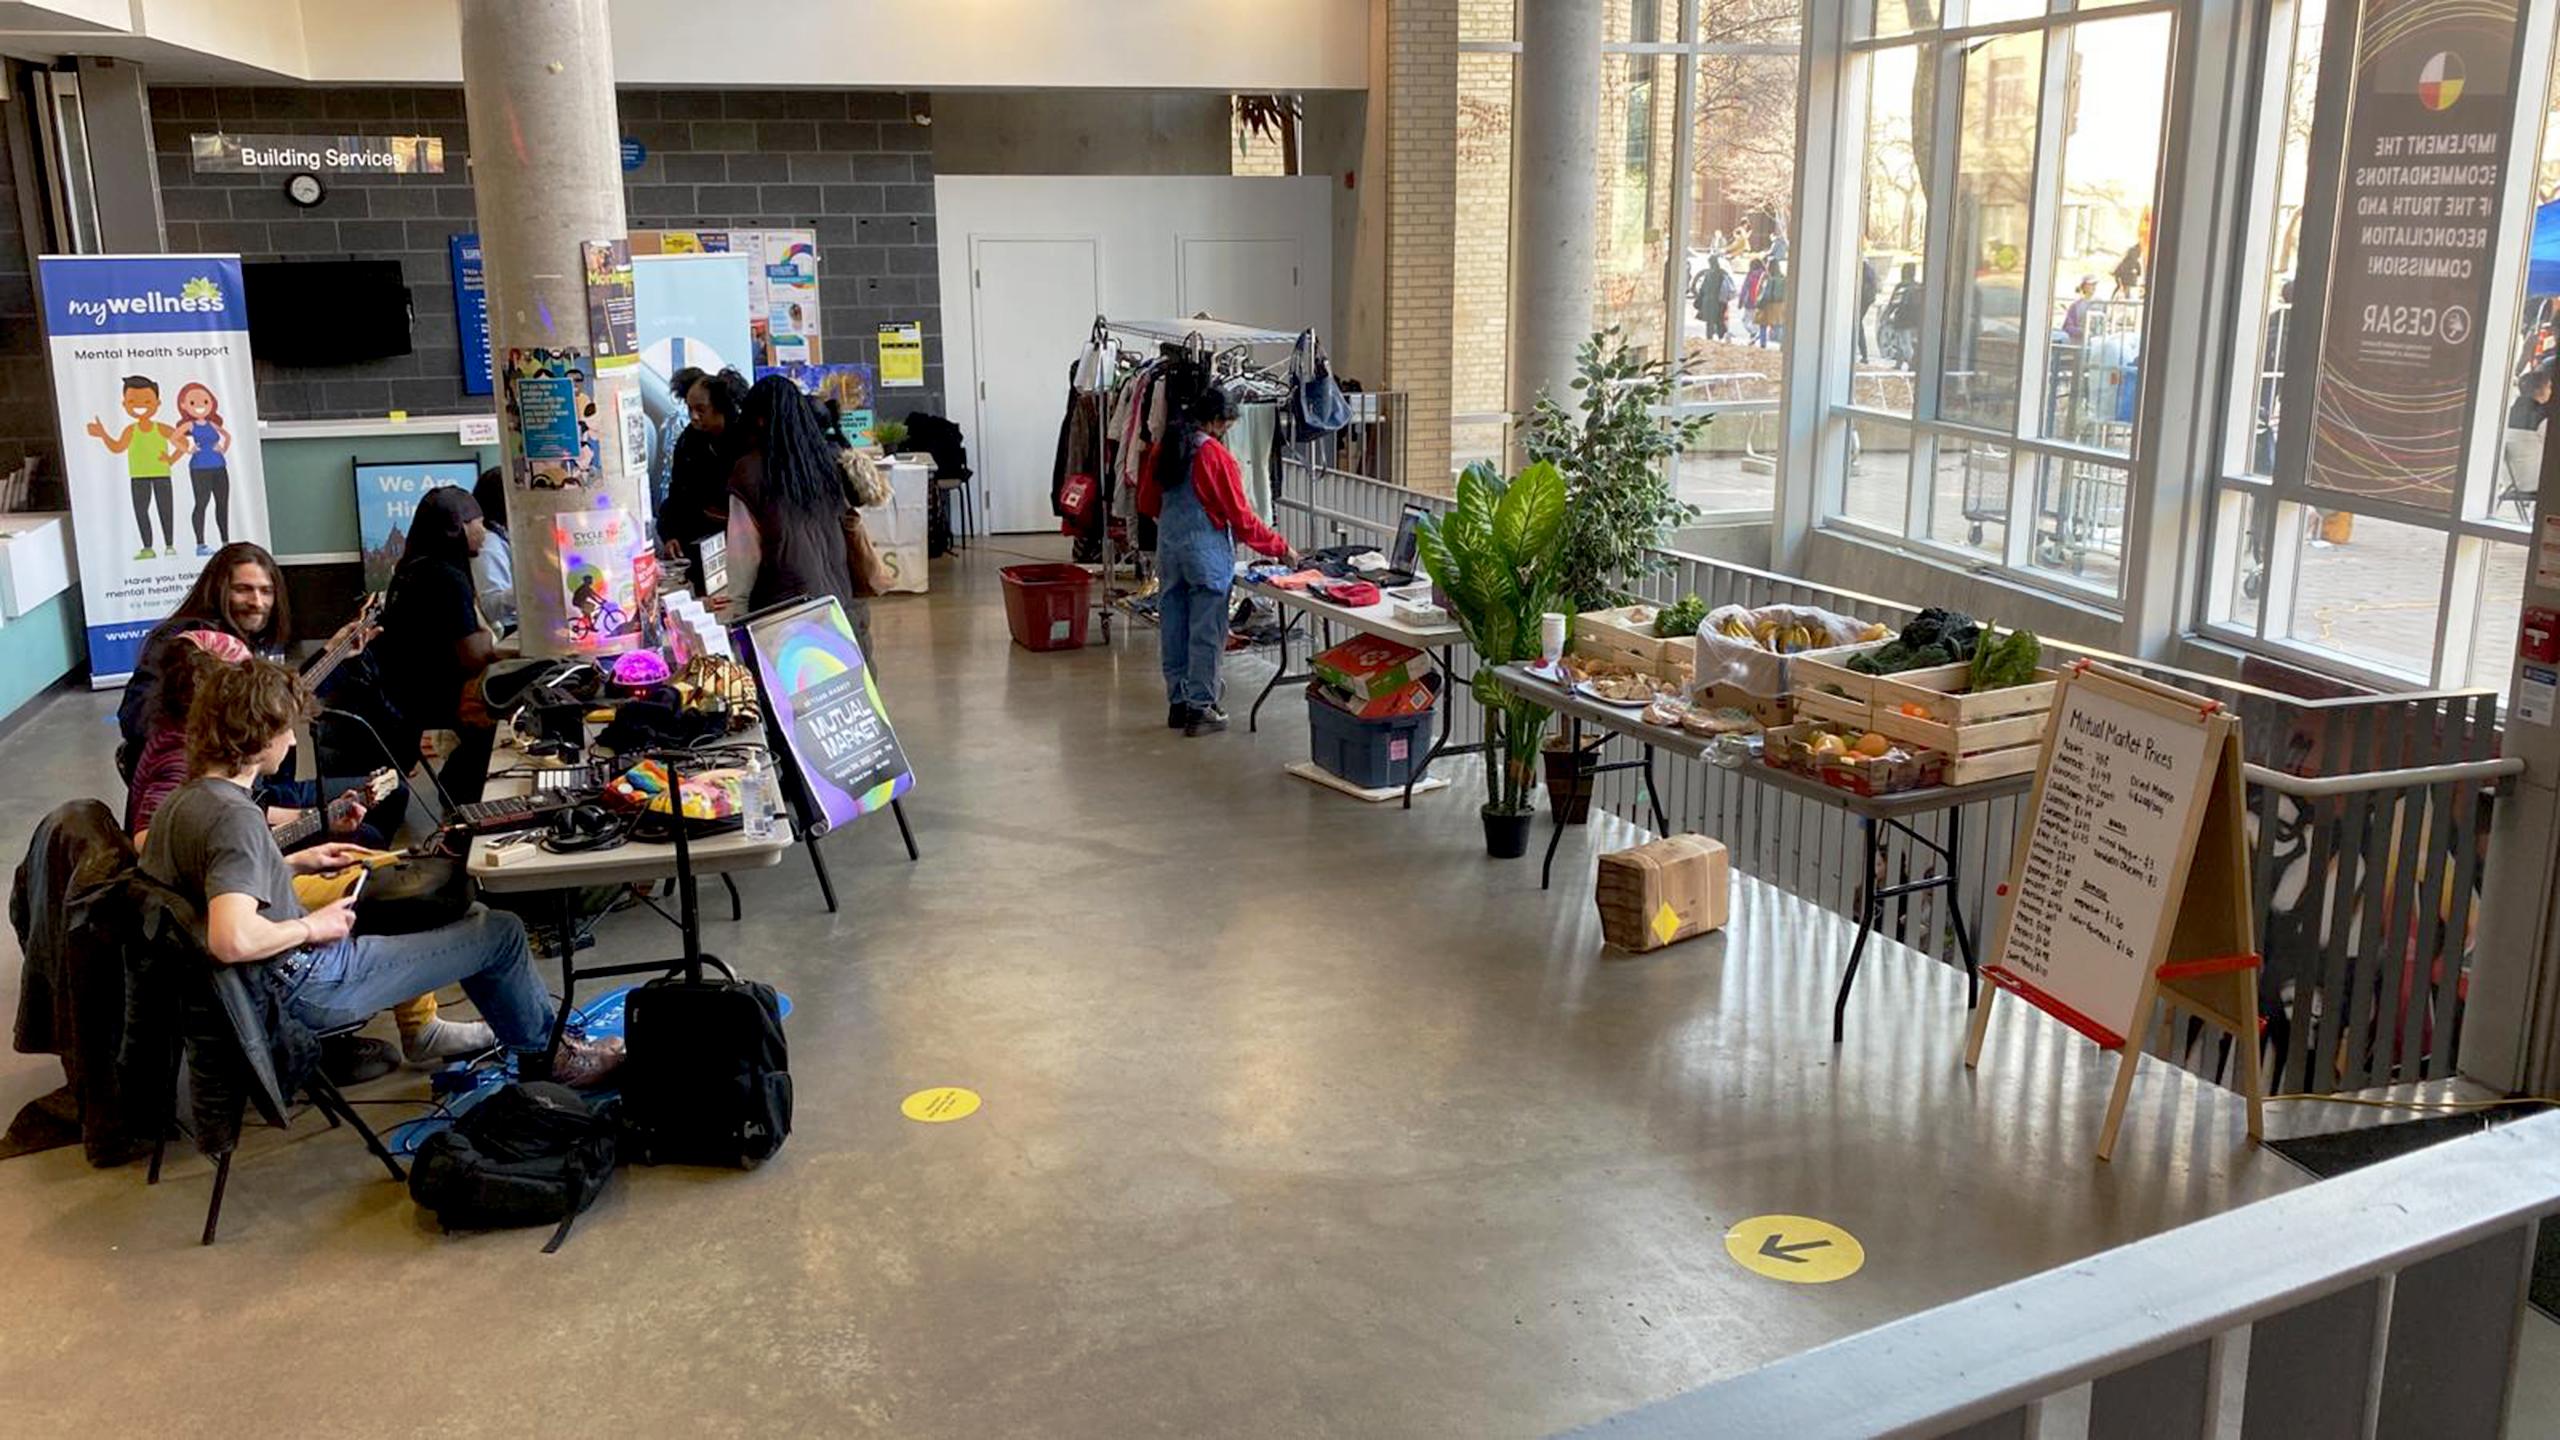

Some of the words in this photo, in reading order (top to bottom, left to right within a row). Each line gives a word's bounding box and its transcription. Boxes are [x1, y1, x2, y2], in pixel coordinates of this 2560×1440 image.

[241, 147, 321, 170] Building
[325, 148, 403, 167] Services
[75, 349, 122, 360] Mental
[128, 347, 172, 358] Health
[177, 345, 229, 359] Support
[378, 476, 415, 492] We
[124, 576, 152, 586] Have
[155, 575, 175, 585] you
[105, 588, 144, 599] mental
[148, 584, 183, 595] health
[808, 698, 872, 740] MUTUAL
[821, 716, 880, 759] MARKET
[2069, 709, 2105, 739] Mutual
[2104, 722, 2142, 755] Market
[2144, 737, 2173, 770] Prices
